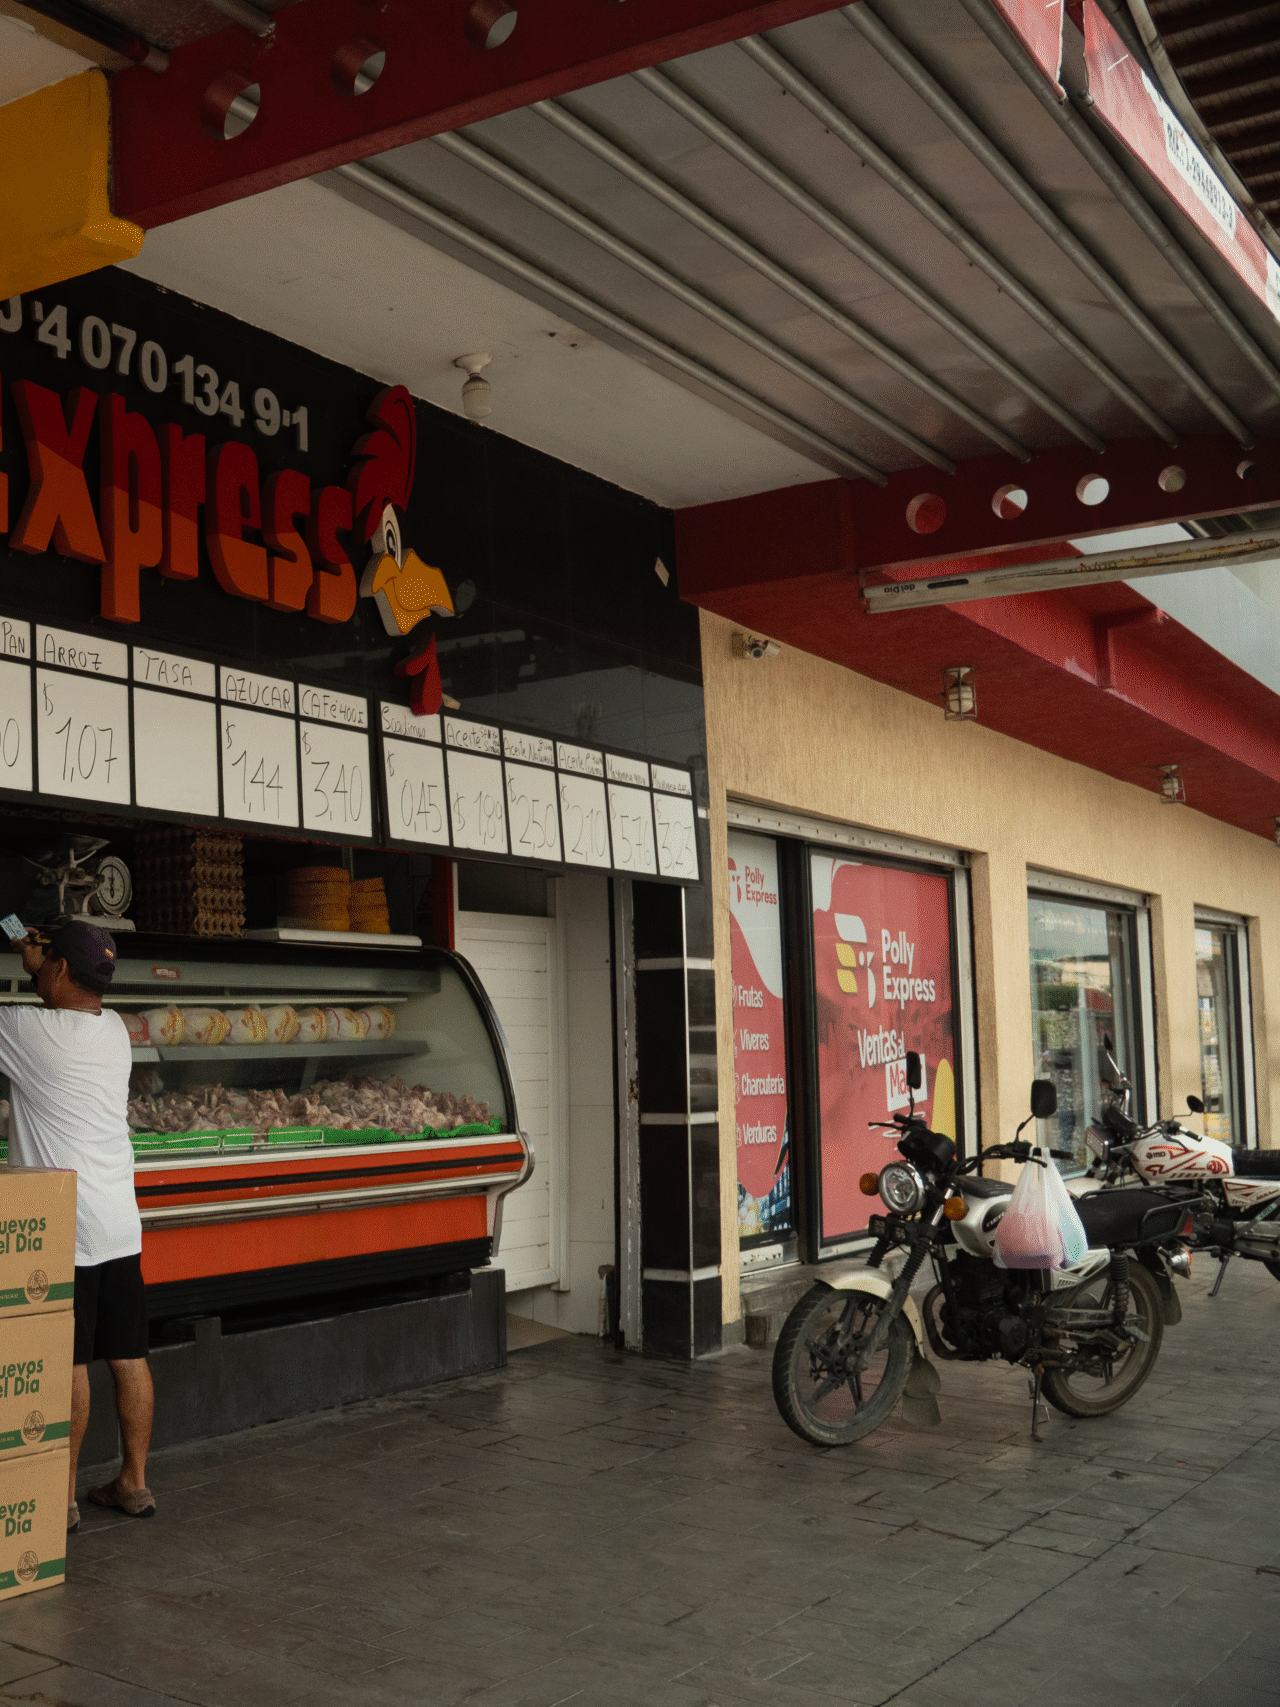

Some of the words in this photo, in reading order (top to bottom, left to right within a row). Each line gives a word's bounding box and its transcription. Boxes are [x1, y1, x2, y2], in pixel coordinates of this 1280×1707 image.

[139, 650, 193, 686] TASA
[225, 675, 292, 711] AZUCAR
[43, 682, 54, 716] $
[55, 717, 117, 784] 1,07
[225, 721, 236, 749] $
[232, 750, 283, 818] 1,44
[302, 731, 312, 755] $
[311, 761, 363, 822] 3,40
[387, 750, 395, 776] $
[401, 779, 442, 833] 0,45
[453, 793, 465, 831] $
[474, 790, 504, 845] 1,89
[507, 774, 516, 803] $
[517, 795, 556, 849] 2,50
[561, 785, 569, 811] $
[570, 805, 607, 862] 2,10
[744, 865, 765, 890] Polly
[745, 883, 777, 907] Express
[881, 928, 915, 975] Polly
[738, 985, 764, 1009] Frutas
[883, 966, 936, 1010] Express
[857, 1024, 897, 1069] Ventas
[897, 1030, 906, 1058] al
[743, 1121, 778, 1146] Verduras
